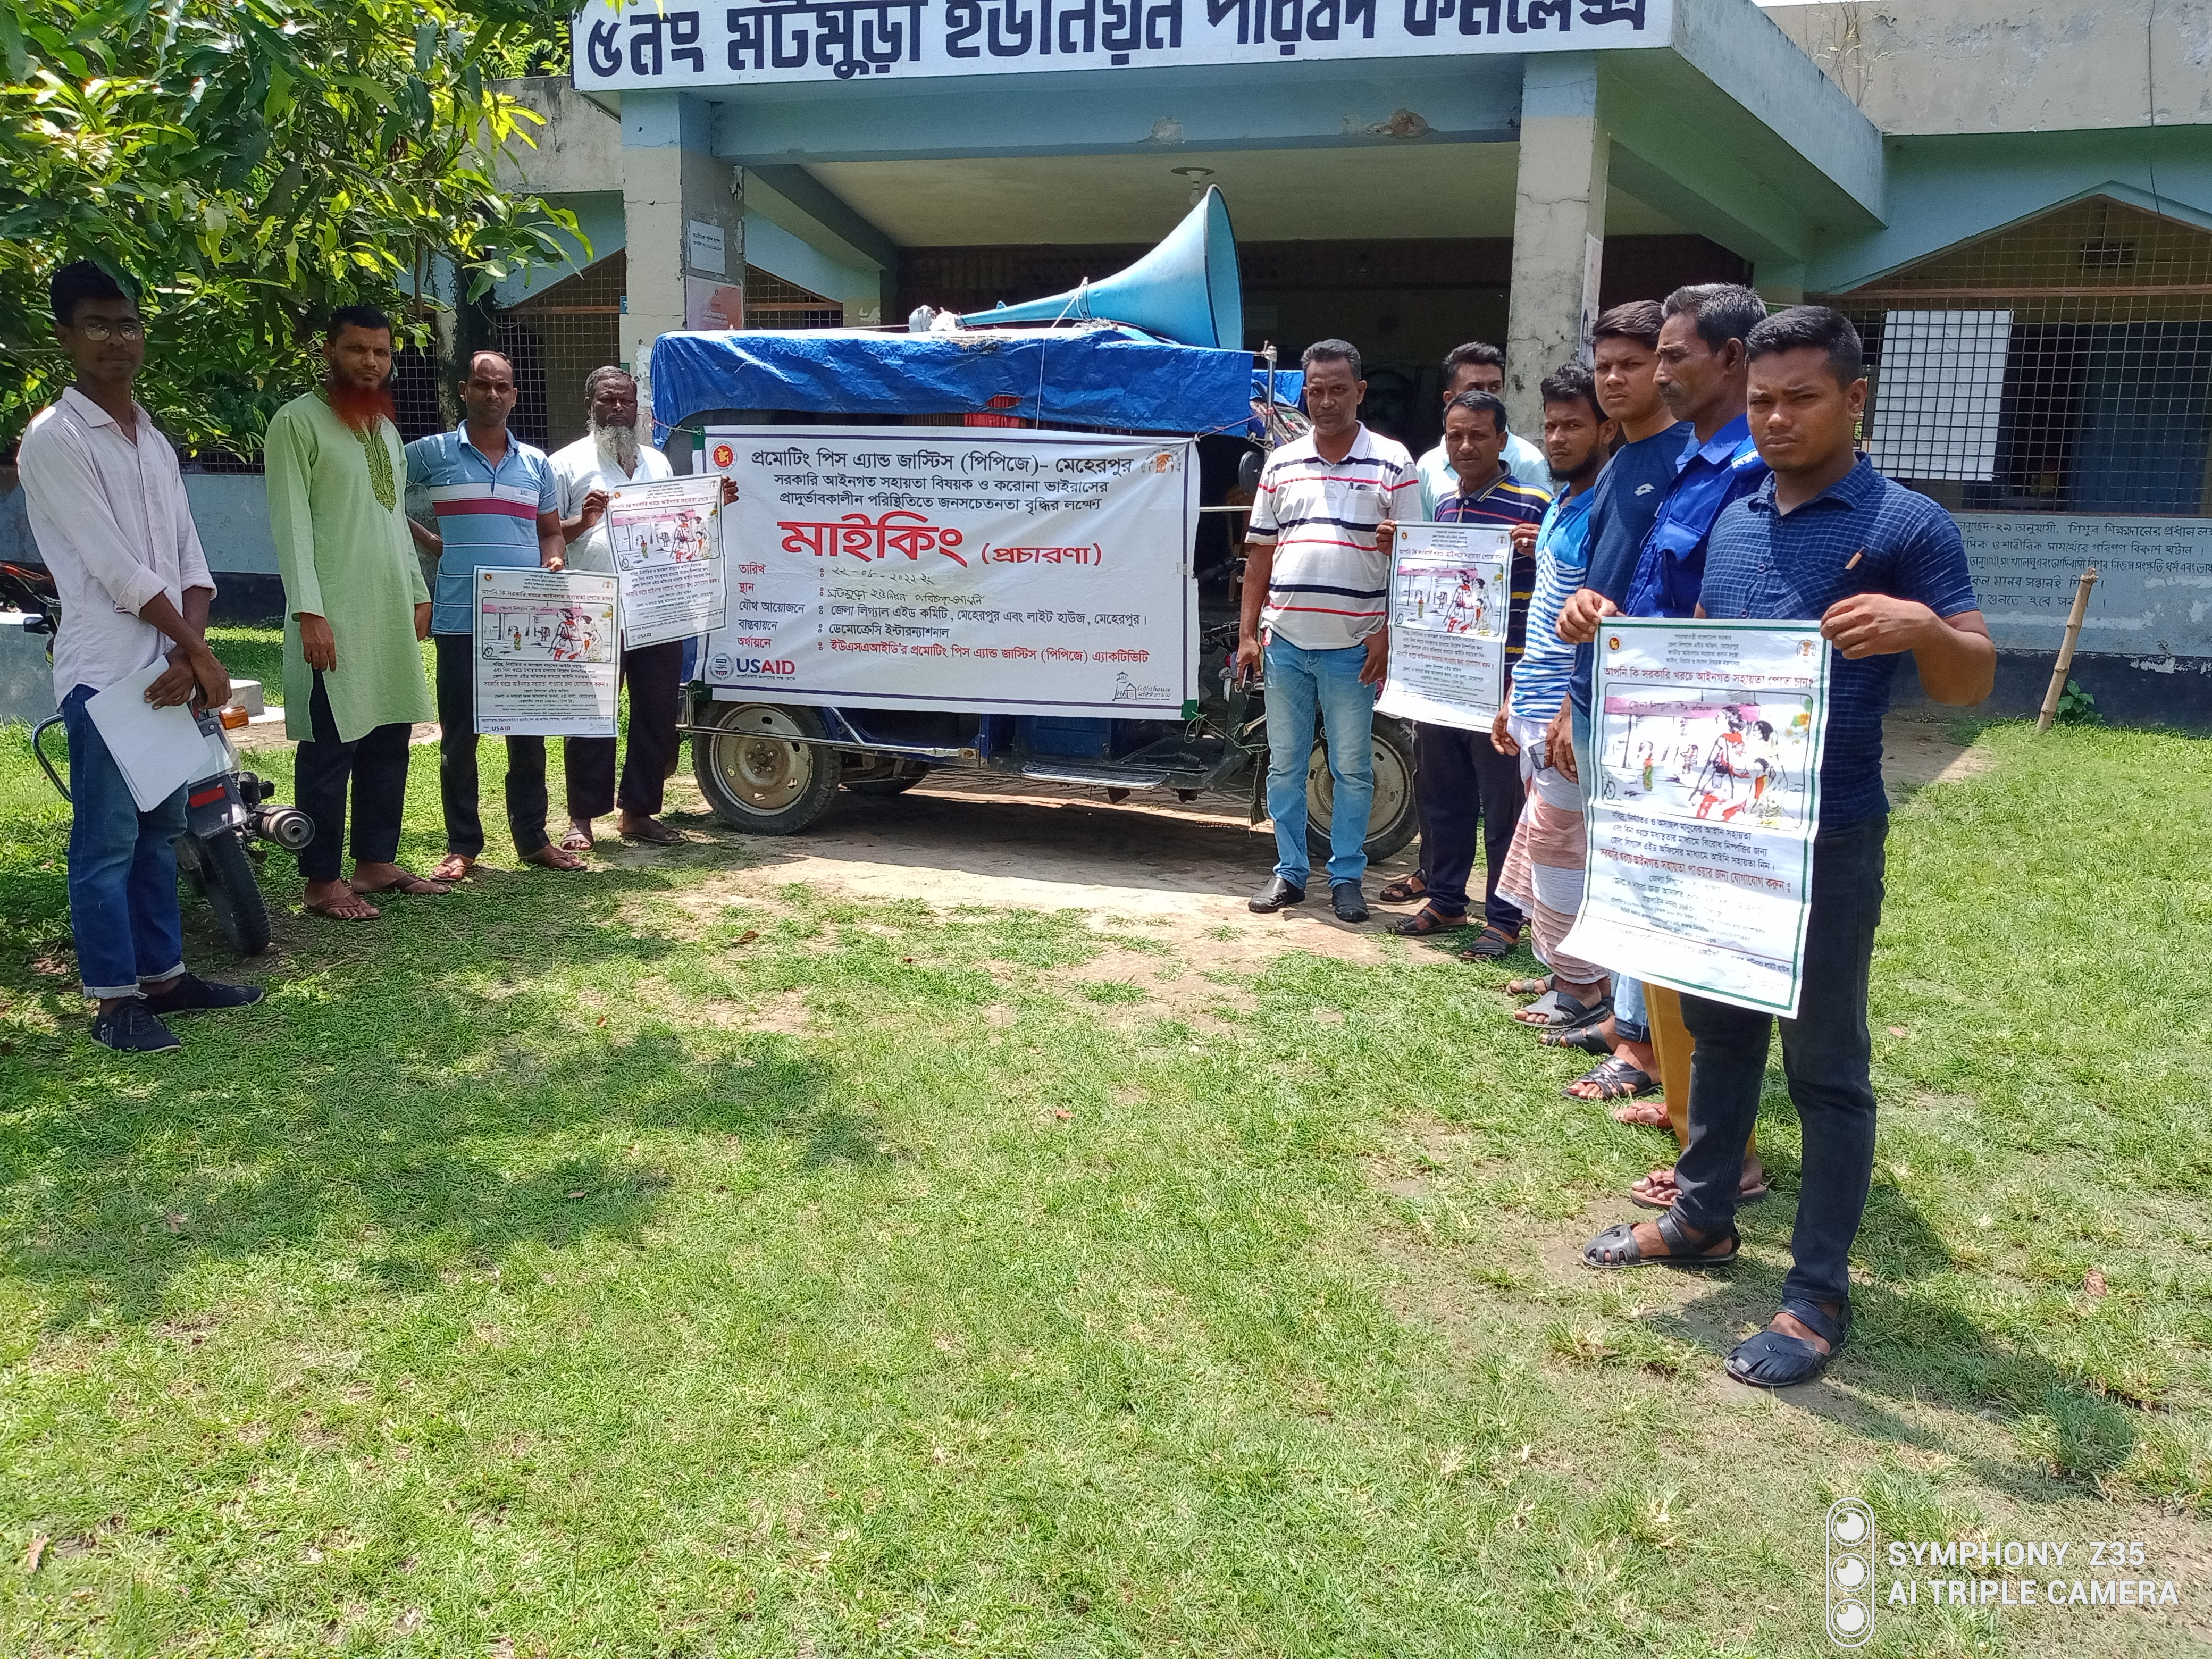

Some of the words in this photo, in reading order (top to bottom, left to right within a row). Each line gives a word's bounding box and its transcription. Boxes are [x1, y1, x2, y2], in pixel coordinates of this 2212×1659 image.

[588, 11, 705, 77] ৫নং
[726, 0, 928, 79] মটমুড়া
[751, 447, 811, 468] প্রমোটিং
[816, 447, 848, 467] পিস
[896, 449, 954, 471] জাস্টিস
[1055, 457, 1134, 477] মেহেরপুর
[773, 472, 818, 487] সরকারি
[822, 473, 876, 487] আইনগত
[881, 477, 926, 489] সহায়তা
[931, 475, 973, 491] বিষয়ক
[977, 480, 989, 491] ও
[994, 480, 1040, 493] করোনা
[1044, 480, 1109, 493] ভাইরাসের
[780, 490, 864, 507] প্রাদুর্ভাবকালীন
[868, 493, 934, 509] পরিস্থিতিতে
[937, 497, 1020, 511] জনসচেতনতা
[1025, 497, 1060, 516] বৃদ্ধির
[1063, 498, 1102, 511] লক্ষ্যে
[777, 510, 968, 567] মাইকিং
[980, 543, 1101, 566] (প্রচারণা)
[2067, 522, 2099, 537] শিশুর
[2164, 525, 2196, 537] প্রধান
[1993, 541, 1999, 550] ও
[2131, 541, 2162, 554] বিকাশ
[739, 562, 766, 575] তারিখ
[2037, 558, 2050, 568] এবং
[2166, 560, 2180, 572] ধর্ম
[2180, 562, 2195, 572] এবং
[739, 582, 754, 593] স্থান
[1994, 577, 2022, 586] মানব
[2029, 596, 2052, 607] হবে
[739, 600, 759, 611] যৌথ
[761, 602, 806, 615] আয়োজনে
[831, 605, 854, 617] জেলা
[857, 604, 890, 617] লিগ্যাল
[892, 605, 916, 618] এইড
[957, 610, 1000, 624] মেহেরপুর
[1003, 612, 1024, 623] এবং
[1027, 609, 1054, 624] লাইট
[1057, 610, 1091, 627] হাউজ,
[739, 619, 778, 632] বাস্তবায়নে
[829, 623, 883, 635] ডেমোক্রেসি
[885, 623, 950, 638] ইন্টারন্যাশনাল
[737, 636, 771, 649] অর্থায়নে
[910, 644, 947, 658] প্রমোটিং
[950, 645, 970, 658] পিস
[1001, 647, 1036, 660] জাস্টিস
[1041, 647, 1088, 664] (পিপিজে)
[736, 658, 795, 675] USAID
[1604, 666, 1627, 678] আপনি
[1630, 666, 1639, 678] কি
[1641, 668, 1671, 680] সরকারি
[1674, 671, 1694, 681] খরচে
[1697, 669, 1730, 683] আইনগত
[1733, 674, 1765, 685] সহায়তা
[1768, 676, 1791, 686] পেতে
[1794, 677, 1814, 689] চান?
[1680, 823, 1702, 834] মানুষের
[1704, 826, 1724, 837] আইনি
[1726, 830, 1752, 841] সহায়তা
[1644, 841, 1657, 852] এইড
[1686, 850, 1708, 860] মাধ্যমে
[1711, 853, 1729, 864] আইনি
[1731, 857, 1756, 868] সহায়তা
[1758, 859, 1770, 870] নিন
[1678, 835, 1699, 845] মাধ্যমে
[1702, 837, 1722, 850] বিরোধ
[1753, 847, 1768, 857] জন্য
[1633, 854, 1659, 869] আইনগত
[1661, 860, 1686, 874] সহায়তা
[1688, 864, 1713, 878] পাওয়ার
[1715, 869, 1729, 882] জন্য
[1731, 872, 1764, 888] যোগাযোগ
[1765, 877, 1785, 892] করুন
